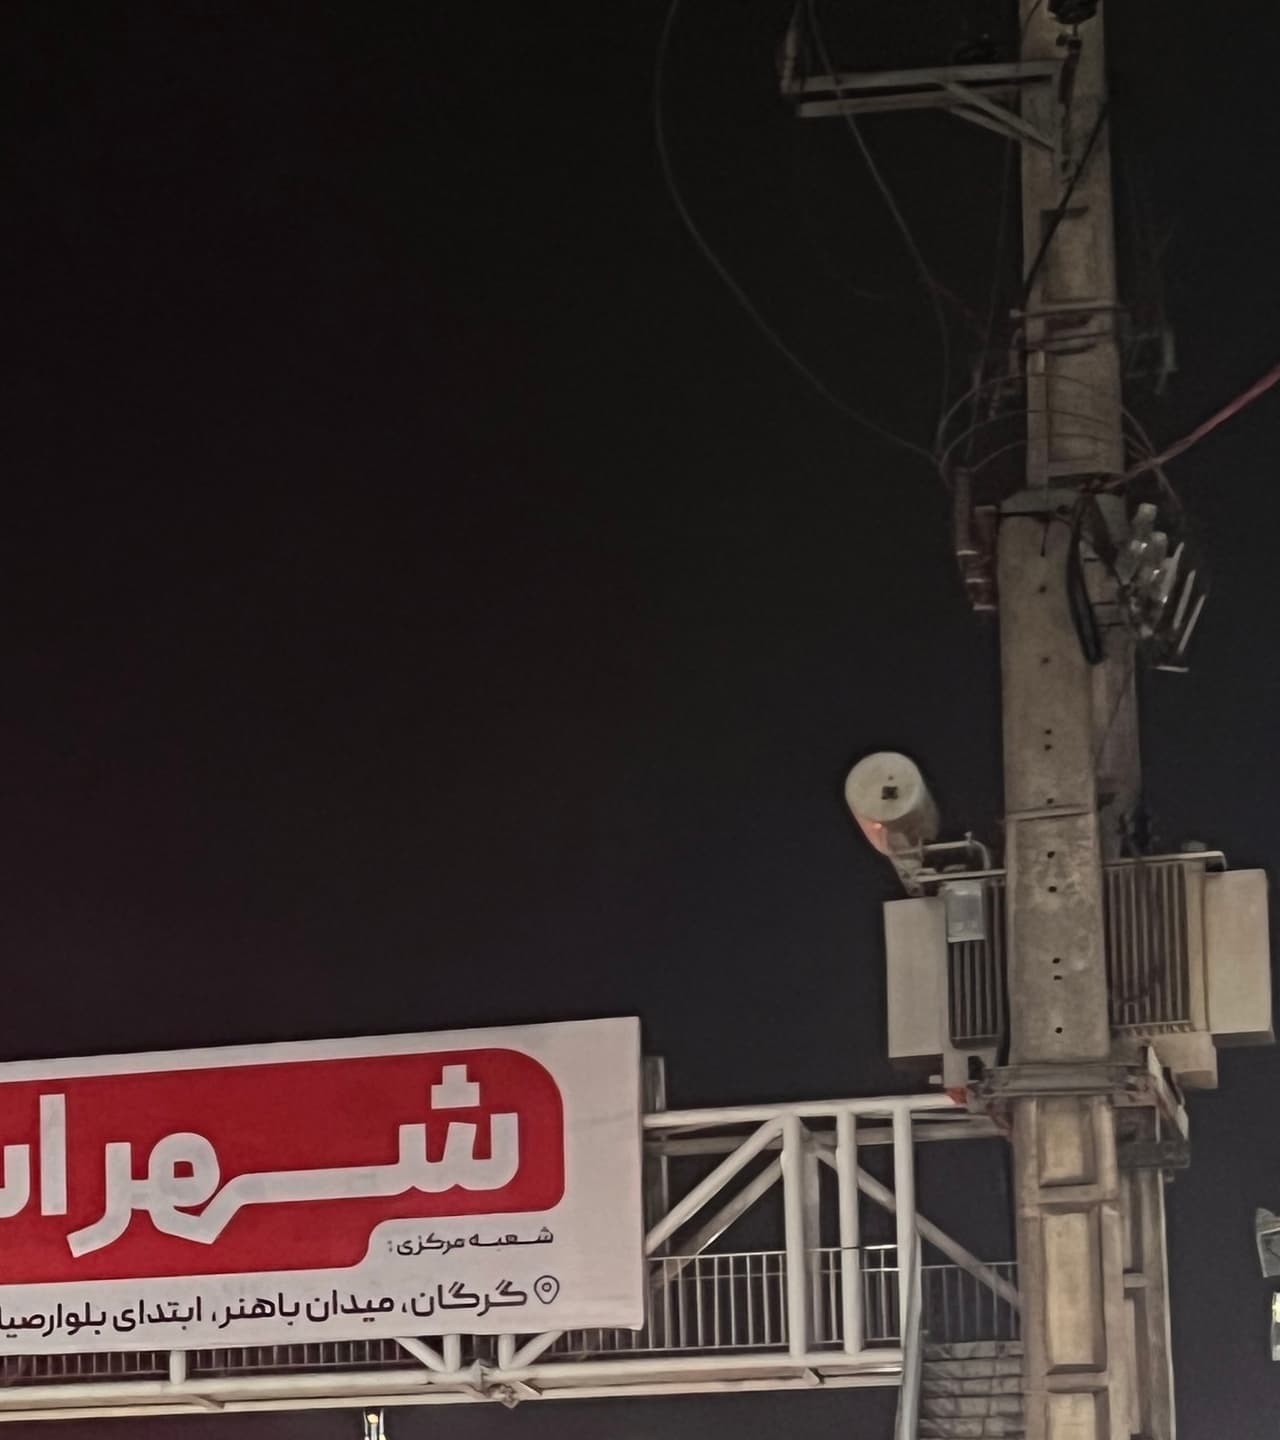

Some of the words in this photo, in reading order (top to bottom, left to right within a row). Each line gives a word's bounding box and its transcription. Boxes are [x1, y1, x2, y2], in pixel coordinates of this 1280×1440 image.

[66, 1064, 519, 1258] شهر
[469, 1226, 554, 1251] شعبه
[112, 1296, 202, 1332] ابتدای
[305, 1289, 394, 1323] میدان
